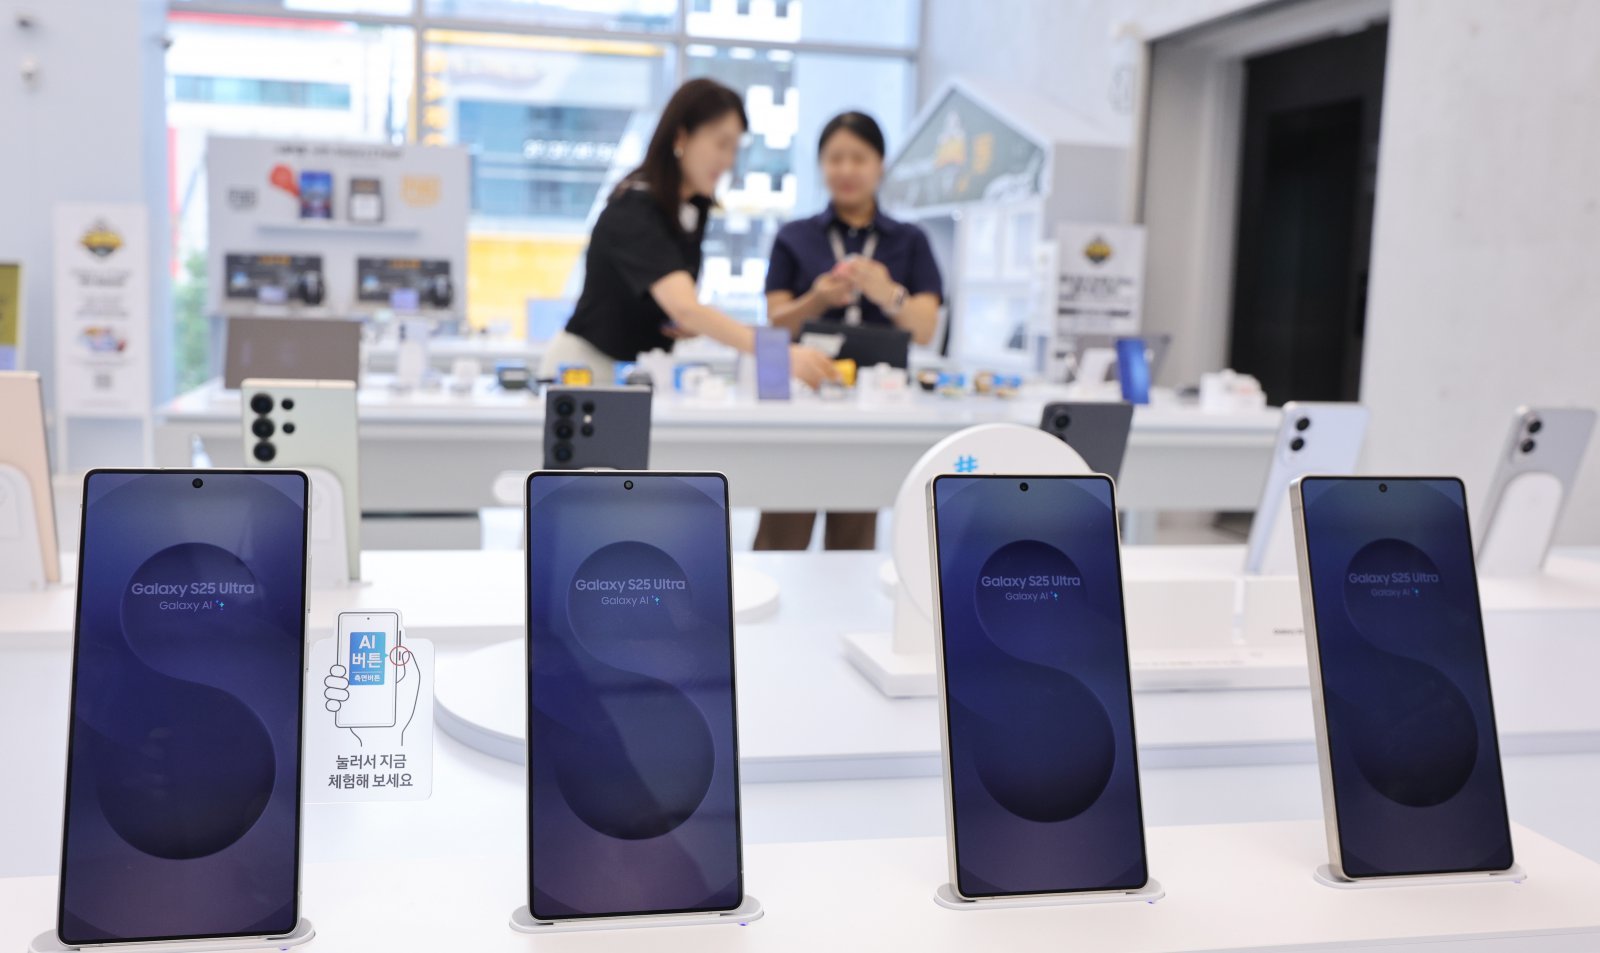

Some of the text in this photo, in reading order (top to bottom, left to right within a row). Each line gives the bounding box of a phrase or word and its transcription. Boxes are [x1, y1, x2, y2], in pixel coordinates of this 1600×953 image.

[981, 576, 1081, 589] Galaxy S25 Ultra
[1348, 573, 1440, 585] Galaxy S25 Ultra
[131, 582, 255, 597] Galaxy S25 Ultra
[575, 579, 686, 593] Galaxy S25 Ultra
[1005, 592, 1049, 602] Galaxy AI
[1370, 588, 1401, 598] Galaxy
[159, 601, 213, 612] Galaxy AI
[601, 596, 649, 607] Galaxy AI
[358, 635, 376, 649] AI
[352, 652, 383, 669] 버튼
[354, 674, 381, 683] 측면버튼
[336, 754, 407, 770] 눌러서 지금
[328, 773, 414, 789] 체험해 보세요
